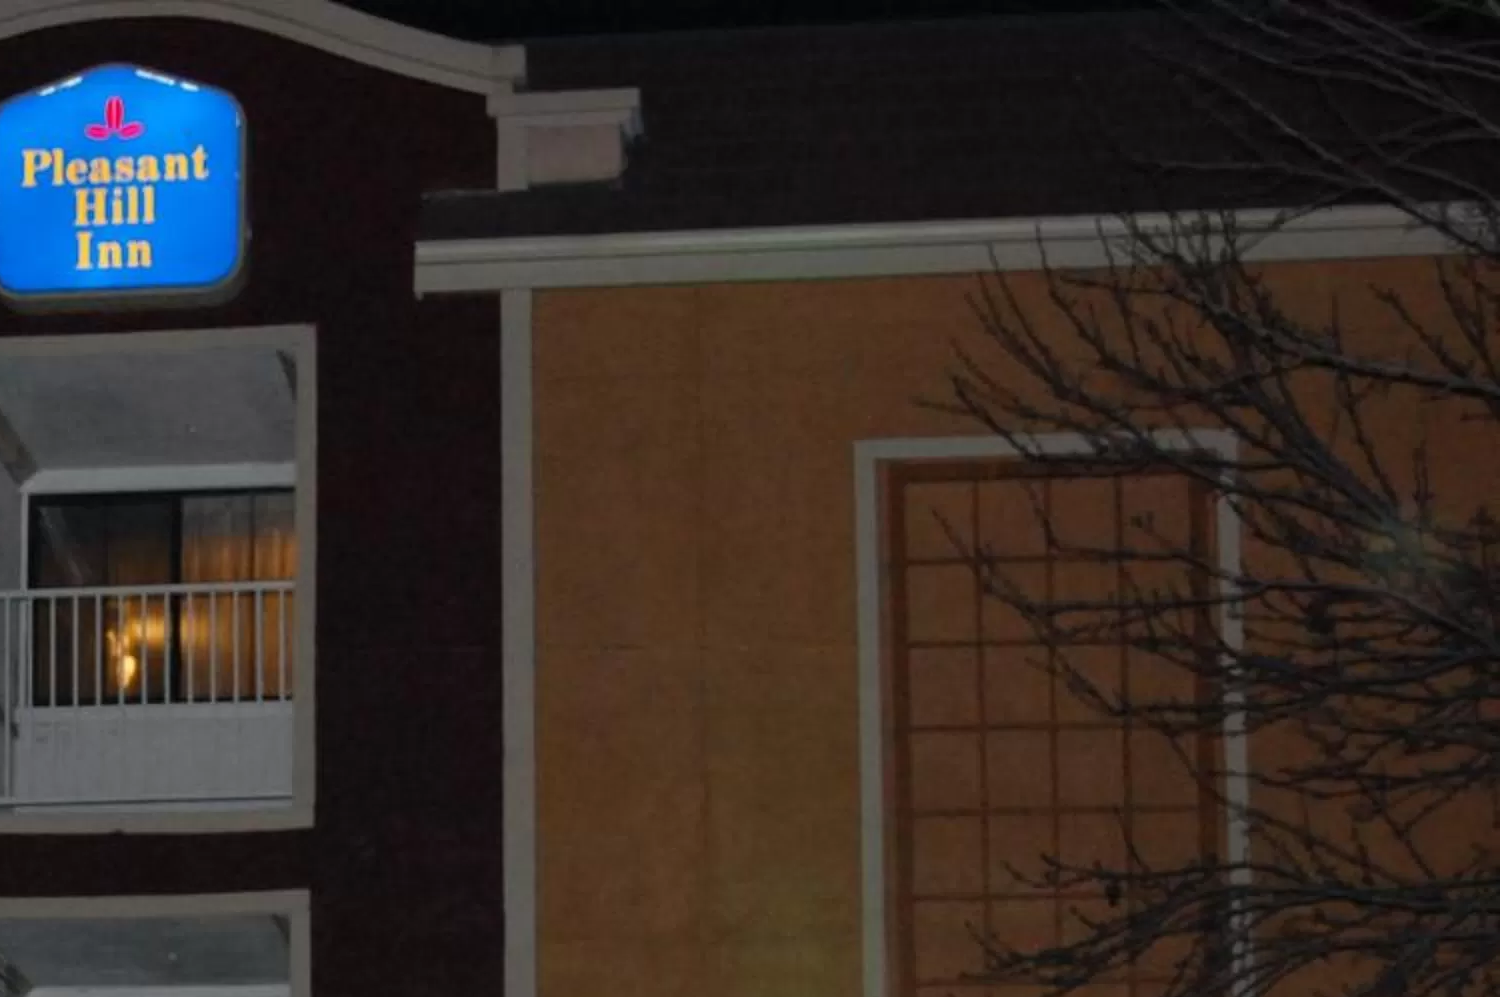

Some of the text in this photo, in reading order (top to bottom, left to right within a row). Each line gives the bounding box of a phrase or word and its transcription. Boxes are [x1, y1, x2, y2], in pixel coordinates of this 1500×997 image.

[21, 144, 210, 188] Pleasant
[74, 185, 156, 227] Hill
[75, 230, 154, 271] Inn
